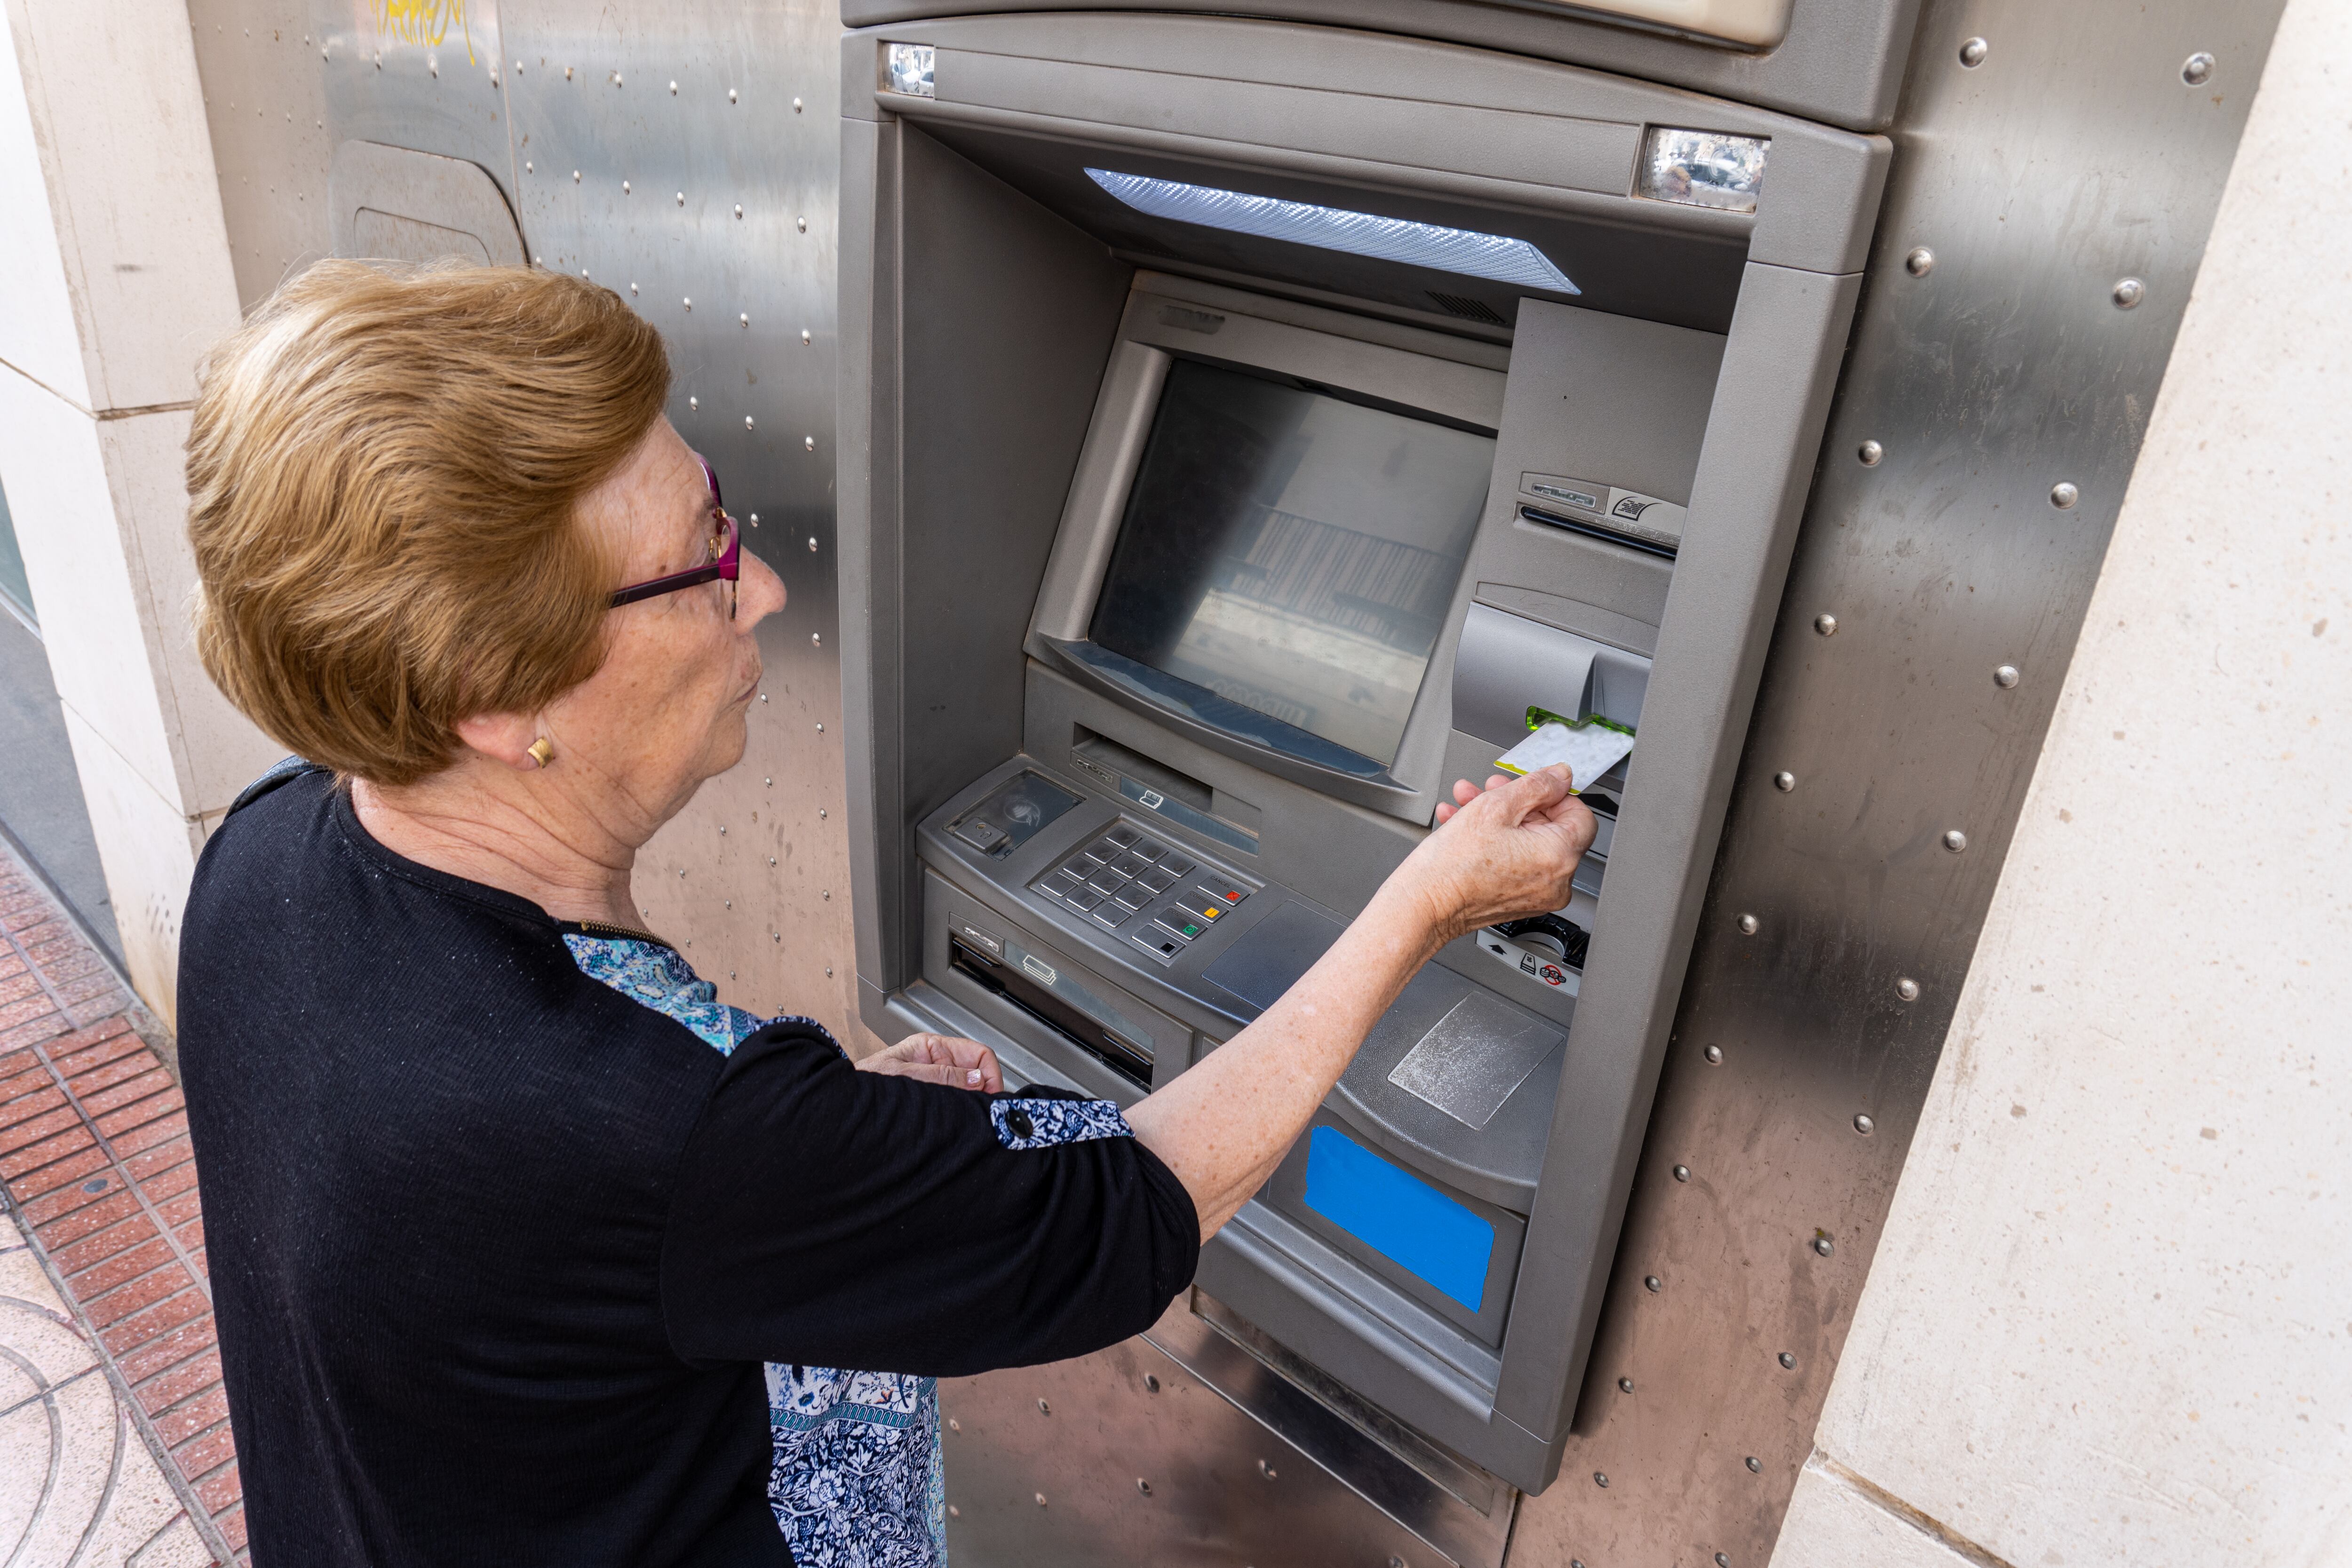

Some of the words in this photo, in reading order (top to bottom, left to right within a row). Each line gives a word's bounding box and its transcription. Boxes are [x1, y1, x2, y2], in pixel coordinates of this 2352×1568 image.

[1104, 880, 1118, 890] 2
[1209, 876, 1231, 889] CANCEL
[1082, 896, 1096, 906] 0
[1189, 891, 1217, 908] CORREGIR
